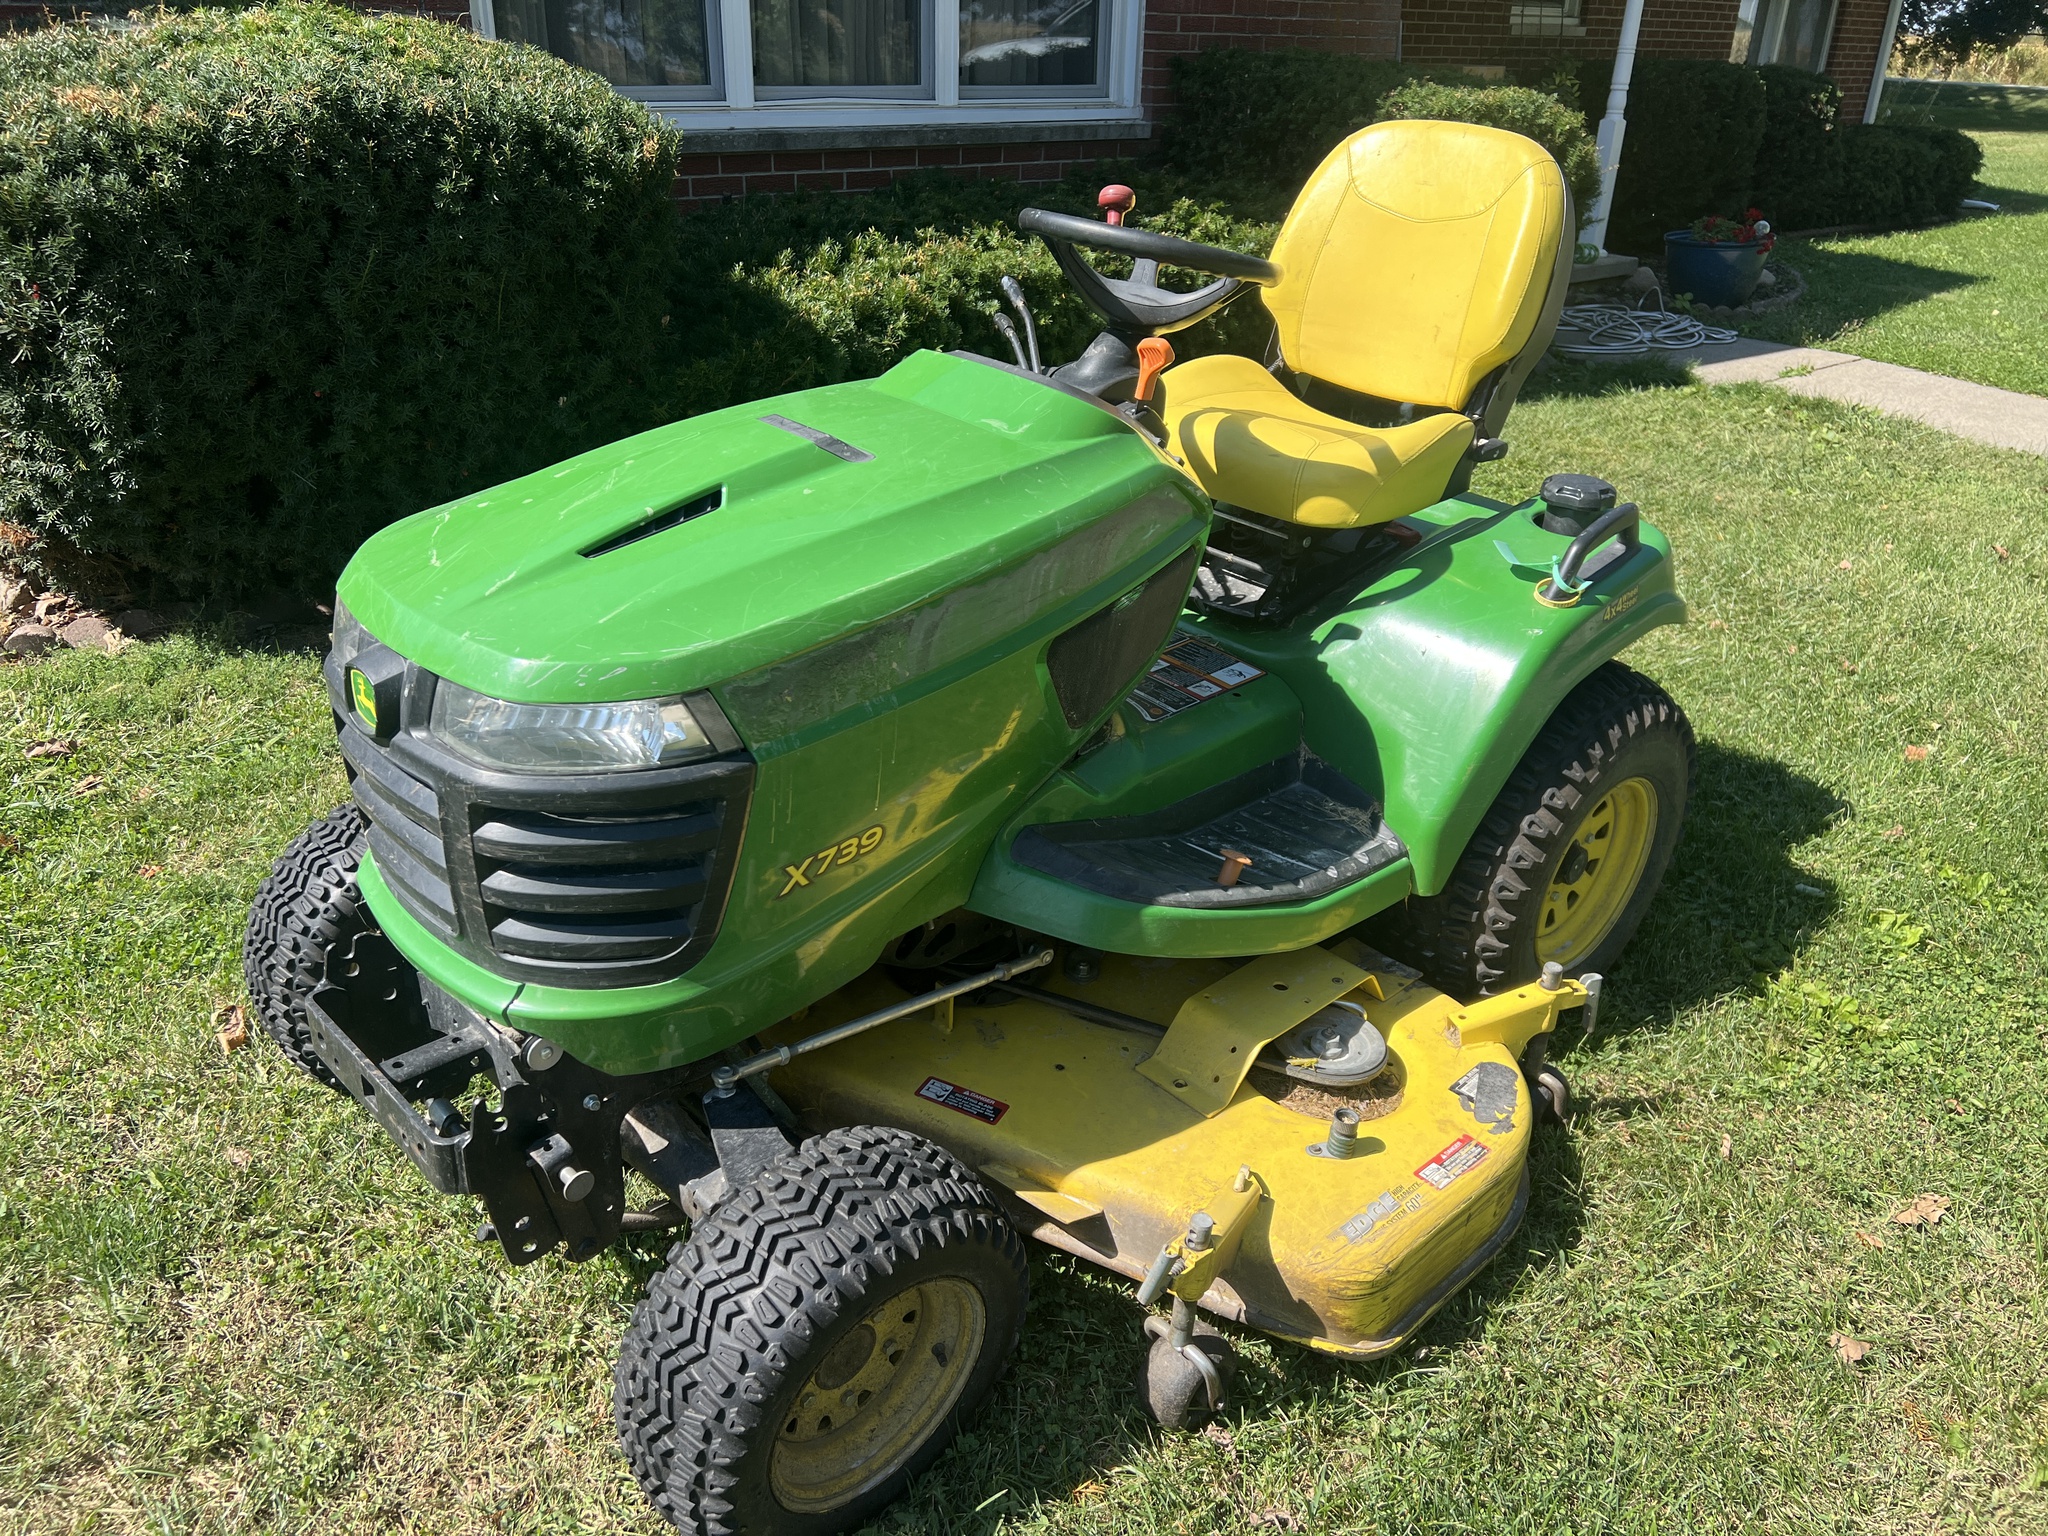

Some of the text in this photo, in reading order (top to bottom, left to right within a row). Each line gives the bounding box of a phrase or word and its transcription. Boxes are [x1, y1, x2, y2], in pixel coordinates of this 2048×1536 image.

[1603, 597, 1623, 620] 4x4
[777, 825, 886, 898] X739
[969, 1092, 996, 1105] DANGER
[1443, 1141, 1463, 1155] DANGER
[1391, 1184, 1405, 1197] HIGH
[1339, 1190, 1402, 1244] EDGE
[1386, 1193, 1422, 1225] SYSTEM 60"
